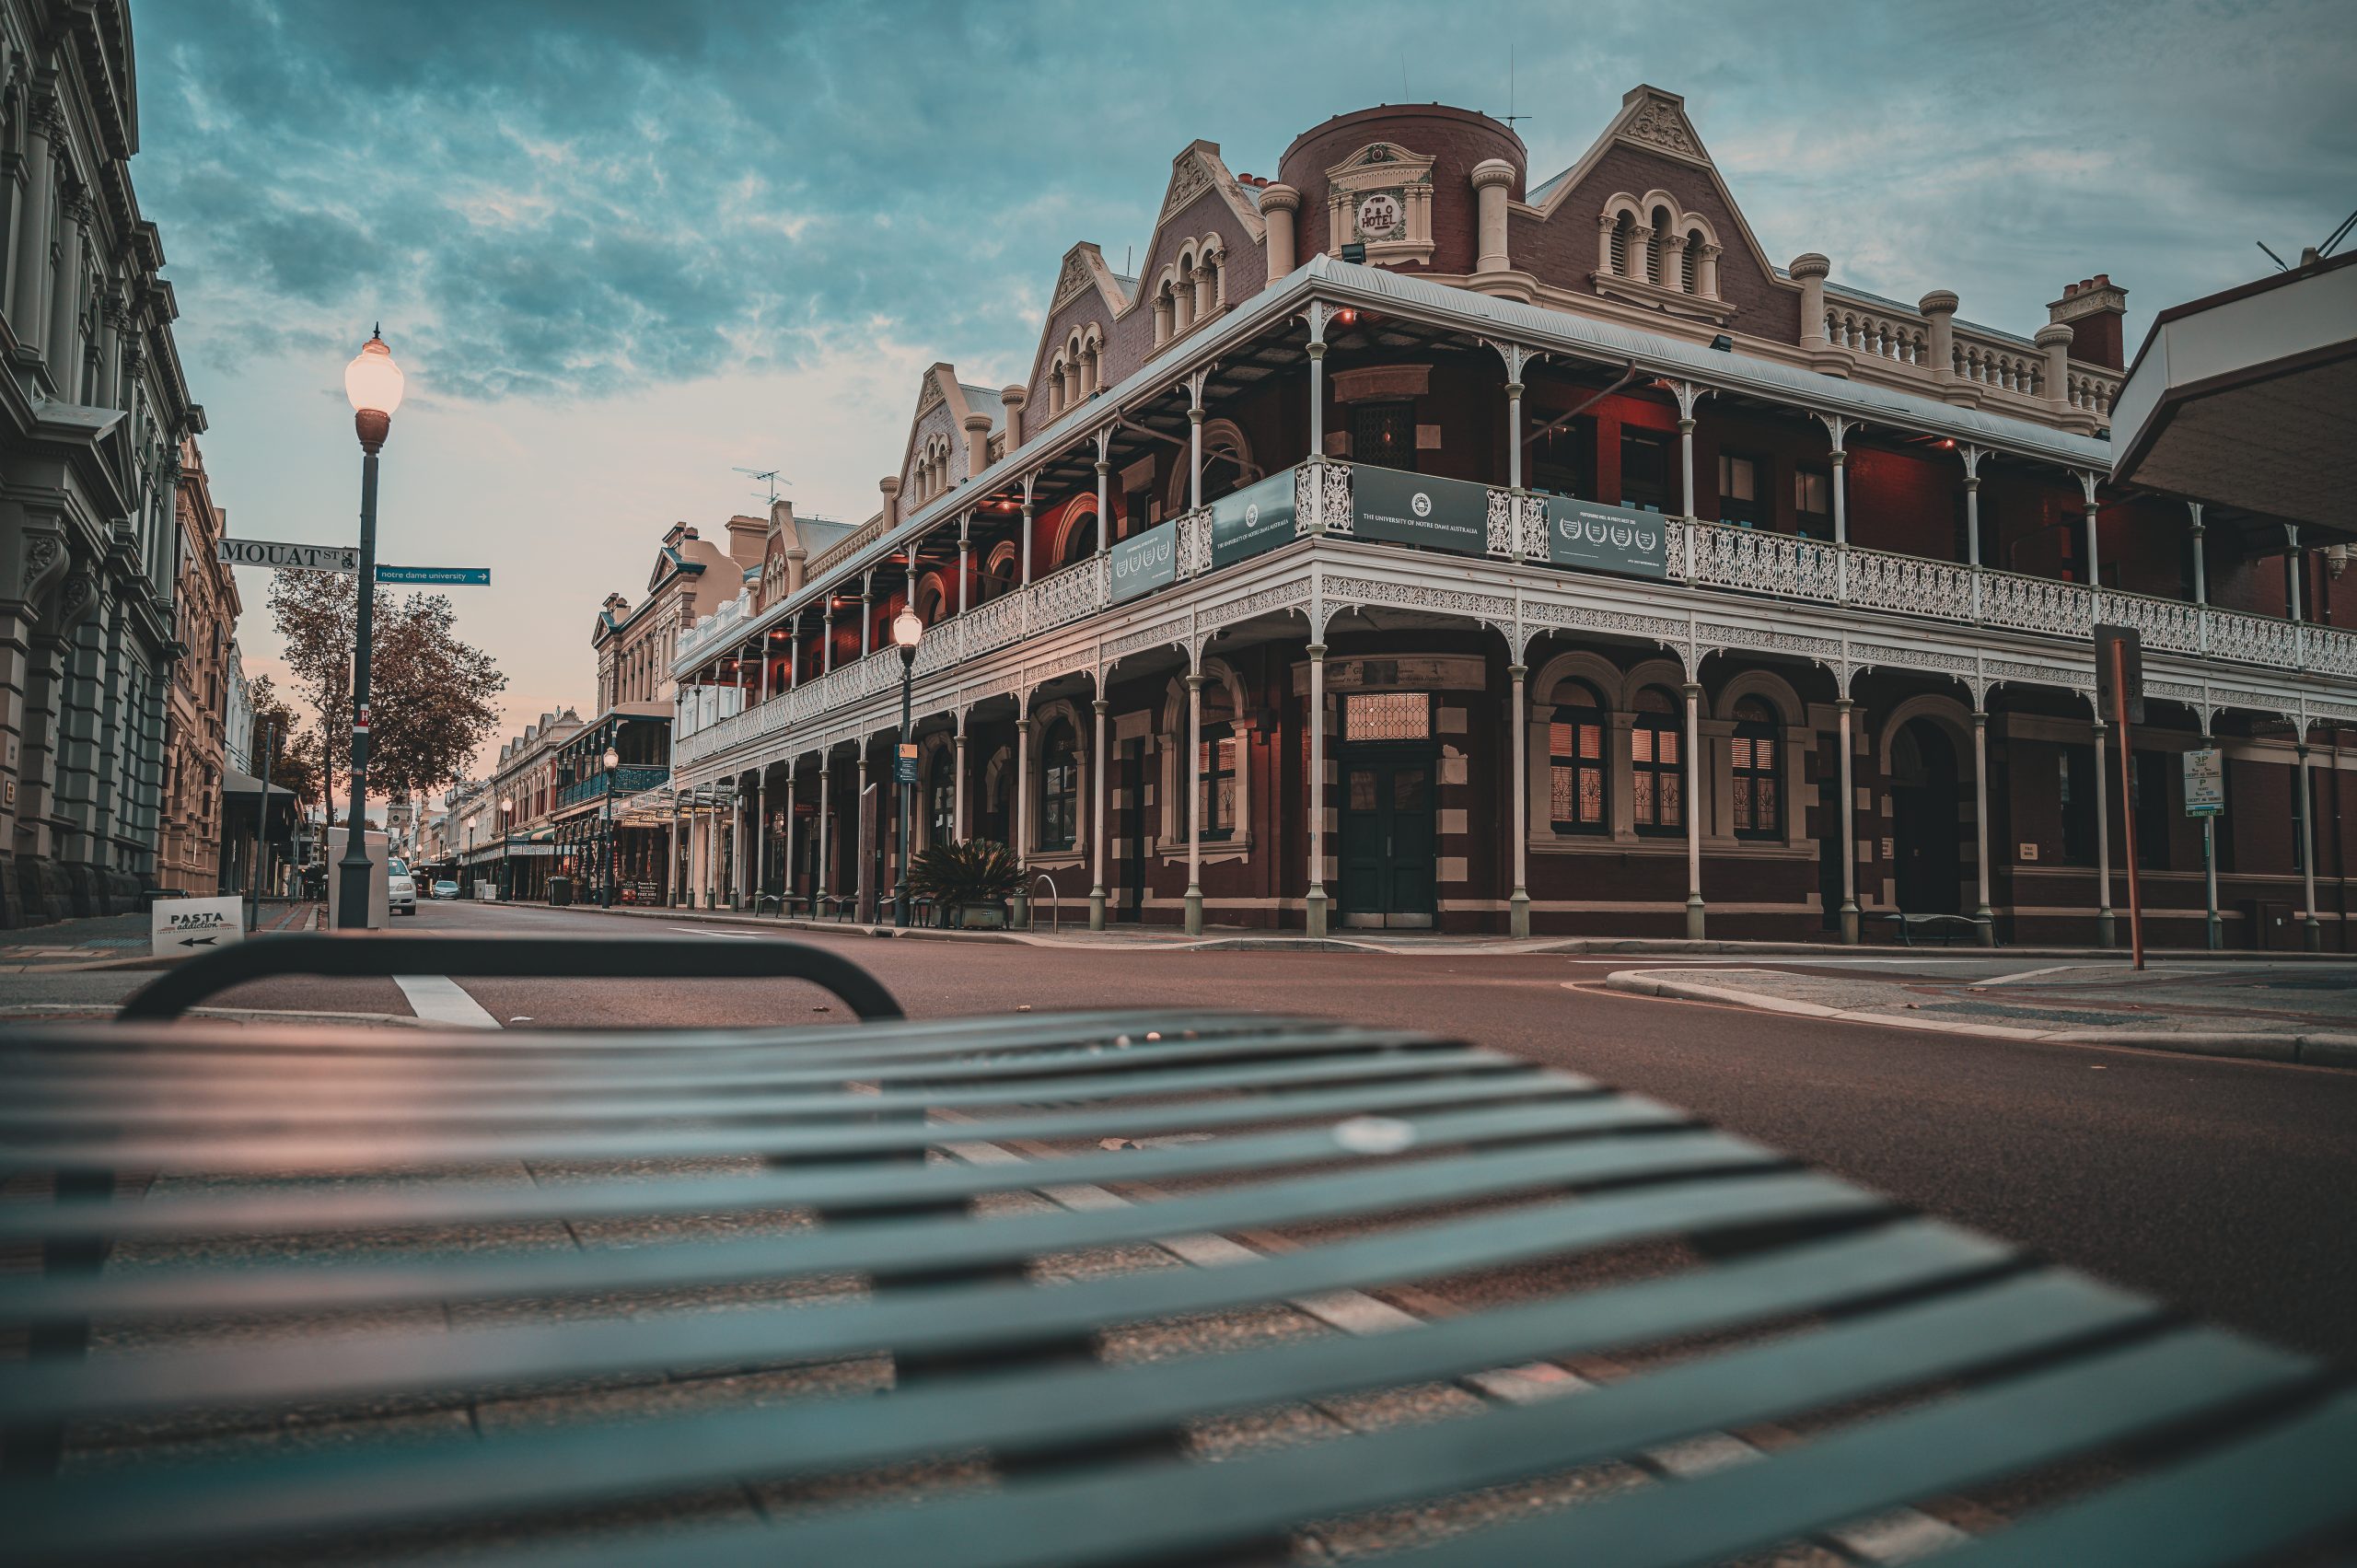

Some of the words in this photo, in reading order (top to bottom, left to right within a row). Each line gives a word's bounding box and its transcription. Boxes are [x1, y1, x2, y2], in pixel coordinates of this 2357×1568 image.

[1364, 207, 1371, 216] P
[1386, 205, 1393, 214] O
[1362, 215, 1397, 227] HOTEL
[1376, 515, 1407, 525] UNIVERSITY
[1450, 525, 1478, 534] AUSTRALIA
[1224, 536, 1243, 547] UNIVERSITY
[1270, 519, 1289, 530] AUSTRALIA
[220, 541, 321, 567] MOUAT
[323, 551, 339, 560] ST
[429, 573, 467, 581] university
[171, 912, 224, 924] PASTA
[177, 920, 219, 930] addiction
